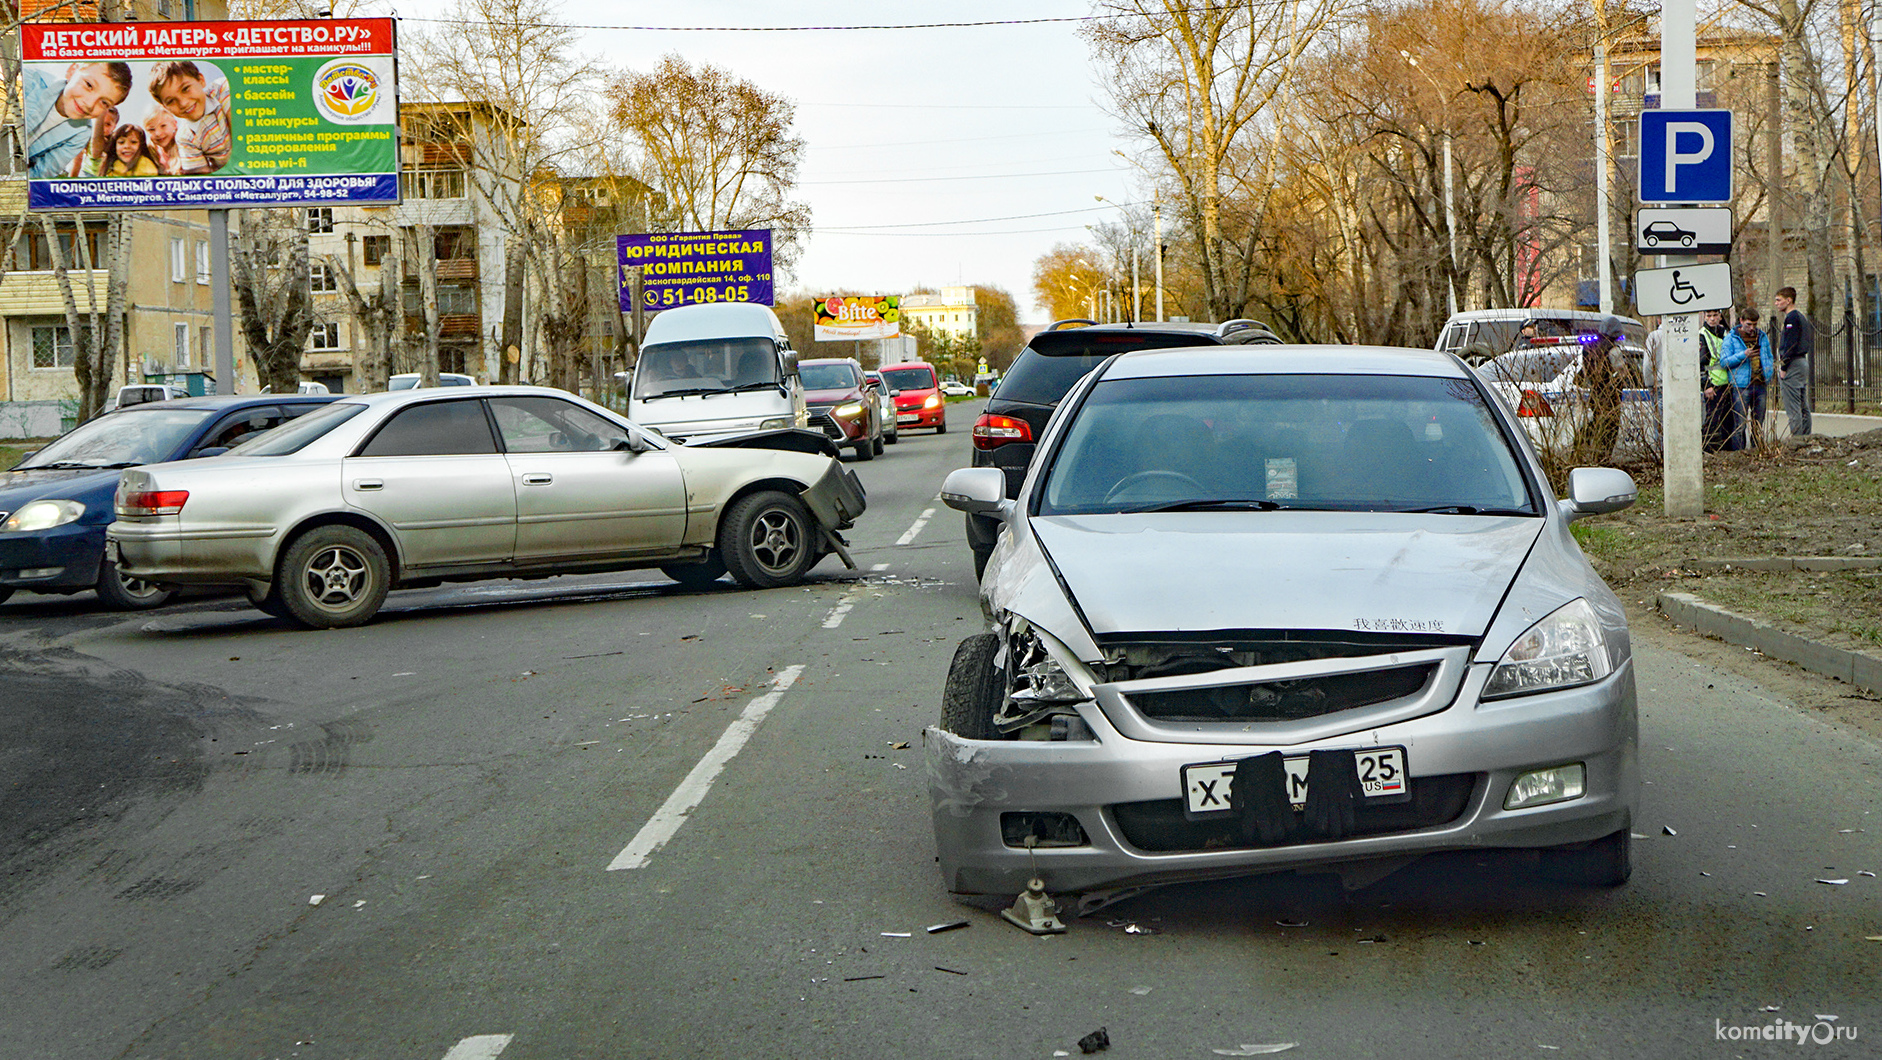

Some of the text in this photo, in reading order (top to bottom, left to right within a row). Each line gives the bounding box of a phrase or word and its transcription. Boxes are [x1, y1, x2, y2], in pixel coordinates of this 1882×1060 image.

[41, 26, 372, 49] ДЕТСКИЙ ЛАГЕРЬ «ДЕТСТВО.РУ»
[43, 42, 372, 58] на базе санатория «Металлург» приглашает на каникулы!!!
[242, 65, 293, 76] мастер-
[243, 75, 290, 85] классы
[243, 89, 296, 101] бассейн
[244, 107, 276, 118] игры
[245, 117, 319, 129] и конкурсы
[246, 131, 390, 145] различные программы
[246, 143, 337, 155] оздоровления
[247, 157, 307, 169] зона wi-fi
[1665, 121, 1715, 193] P
[50, 176, 376, 194] ПОЛНОЦЕННЫЙ ОТДЫХ С ПОЛЬЗОЙ ДЛЯ ЗДОРОВЬЯ!
[80, 194, 95, 204] ул.
[97, 192, 165, 204] Металлургов,
[177, 190, 232, 203] Санаторий
[304, 188, 349, 200] 54-98-52
[669, 234, 711, 243] «Гарантия
[713, 233, 742, 241] Права»
[626, 241, 763, 258] ЮРИДИЧЕСКАЯ
[643, 259, 744, 275] КОМПАНИЯ
[738, 274, 754, 283] оф.
[756, 273, 770, 281] 110
[662, 285, 749, 305] 51-08-05
[838, 303, 877, 321] Bitte
